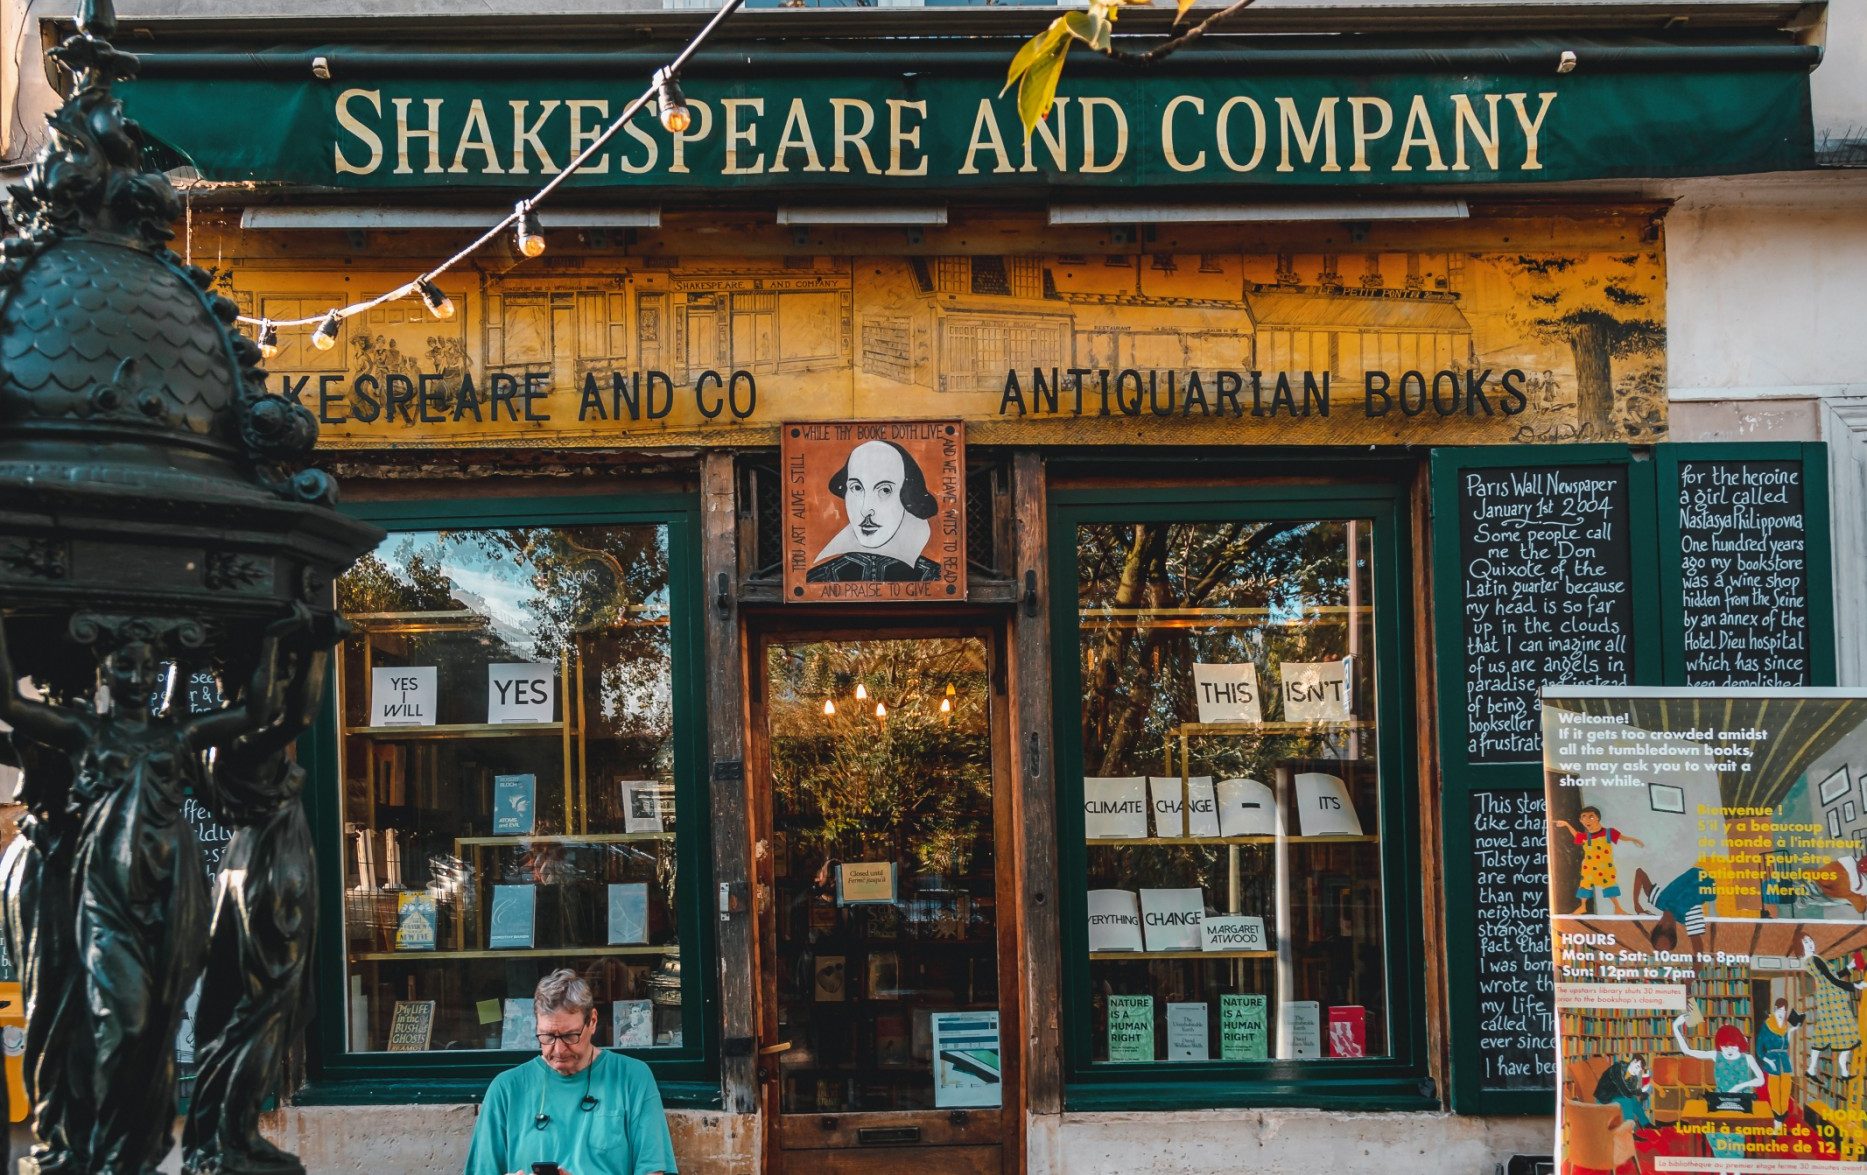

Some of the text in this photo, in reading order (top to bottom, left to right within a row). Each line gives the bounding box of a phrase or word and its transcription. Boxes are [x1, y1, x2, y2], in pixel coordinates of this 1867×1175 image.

[335, 88, 1558, 177] SHAKESPEARE AND COMPANY
[674, 279, 839, 291] SHAKESPEARE AND COMPANY
[578, 370, 674, 421] AND
[695, 370, 756, 419] CO
[999, 368, 1527, 417] ANTIQUARIAN BOOKS
[802, 426, 830, 441] WHILE
[835, 425, 852, 440] THY
[858, 425, 888, 439] BOOKE
[892, 425, 917, 439] DOTH
[791, 454, 804, 483] STILL
[943, 437, 956, 503] AND WE HAVE
[1682, 465, 1798, 487] for the heroine
[1466, 471, 1617, 502] Paris Wall Newspaper
[792, 490, 805, 519] ALIVE
[1473, 497, 1613, 524] January 1st 2004
[792, 525, 805, 545] ART
[1474, 522, 1611, 548] Some people call
[943, 511, 957, 583] WITS TO READ
[1489, 541, 1595, 559] me the Don
[1682, 533, 1804, 559] One hundred years
[792, 549, 806, 572] THOU
[1470, 559, 1607, 580] Quixote of the
[821, 583, 931, 597] AND PRAISE TO GIVE
[1467, 576, 1625, 600] Latin quarter because
[391, 678, 418, 690] YES
[1286, 680, 1343, 702] ISN'T
[402, 691, 405, 703] I
[494, 679, 548, 705] YES
[1201, 682, 1253, 704] THIS
[384, 704, 423, 717] WILL
[1559, 713, 1628, 724] Welcome!
[1559, 728, 1768, 742] If it gets too crowded amidst
[1559, 744, 1754, 757] all the tumbledown books,
[1559, 760, 1751, 774] we may ask you to wait a
[1559, 775, 1645, 787] short while.
[1084, 800, 1142, 814] CLIMATE
[1156, 799, 1213, 813] CHANGE
[1319, 796, 1340, 810] IT'S
[1474, 793, 1511, 814] This
[1697, 804, 1773, 815] Bienvenue
[1751, 819, 1823, 835] beaucoup
[1721, 836, 1772, 848] monde
[1474, 849, 1529, 873] Tolstoy
[1766, 852, 1831, 866] peut-être
[1699, 868, 1838, 882] patienter quelques
[1480, 888, 1543, 906] than my
[1699, 884, 1761, 895] minutes.
[1146, 912, 1201, 926] CHANGE
[1207, 925, 1259, 934] MARGARET
[1211, 934, 1257, 943] ATWOOD
[1562, 934, 1616, 945] HOURS
[1562, 950, 1750, 966] Mon to Sat: 10am to 8pm
[1563, 966, 1695, 981] Sun: 12pm to 7pm
[1480, 976, 1528, 993] wrote
[1111, 999, 1149, 1007] NATURE
[1482, 995, 1546, 1020] my life
[1224, 1010, 1242, 1018] IS A
[393, 1034, 425, 1043] GHOSTS
[1112, 1034, 1141, 1042] RIGHT
[1224, 1033, 1255, 1041] RIGHT
[1676, 1122, 1834, 1137] Lundi à samedi de 10
[1716, 1139, 1835, 1153] Dimanche de 12
